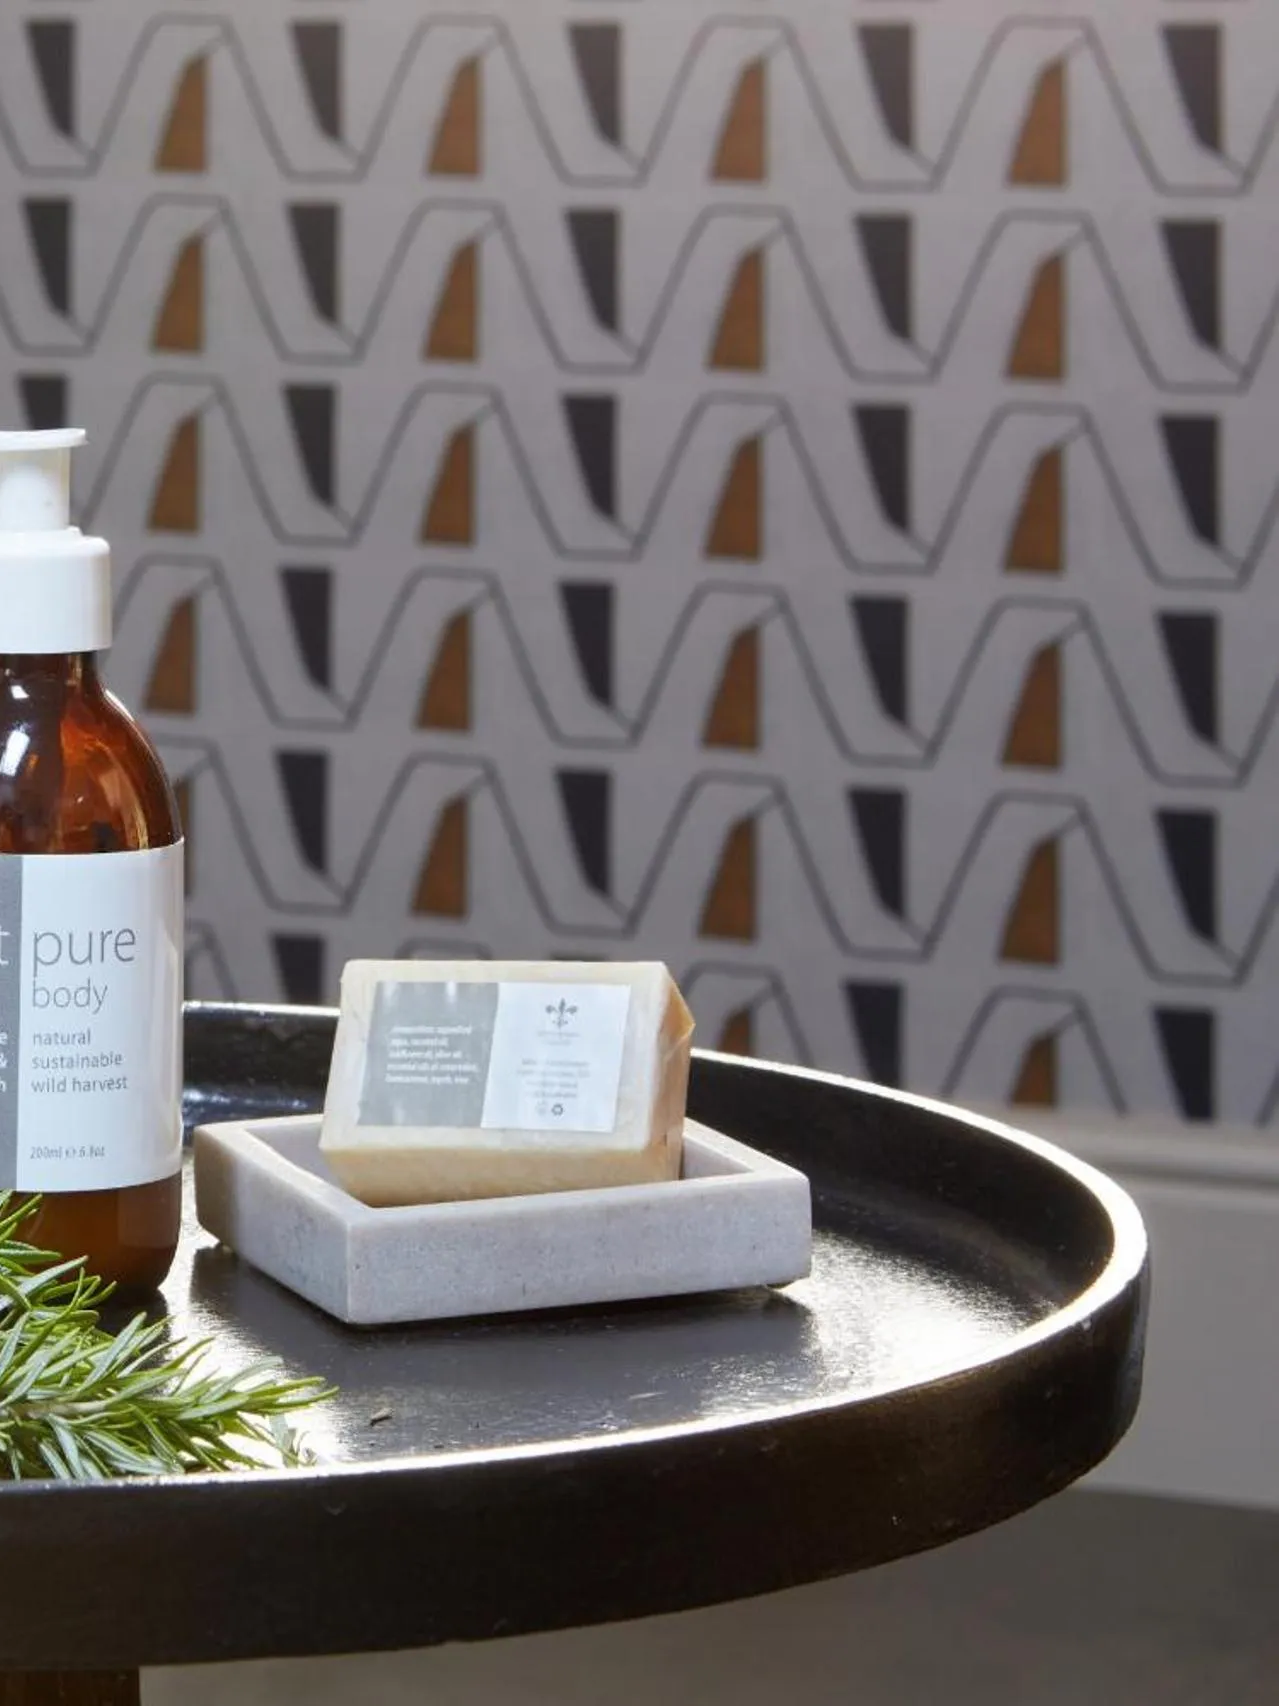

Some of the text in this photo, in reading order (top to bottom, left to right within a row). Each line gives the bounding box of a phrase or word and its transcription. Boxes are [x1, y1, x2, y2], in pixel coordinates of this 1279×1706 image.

[32, 927, 137, 978] pure
[31, 978, 109, 1014] body
[32, 1027, 91, 1046] natural
[30, 1050, 124, 1070] sustainable
[30, 1076, 129, 1094] wild harvest
